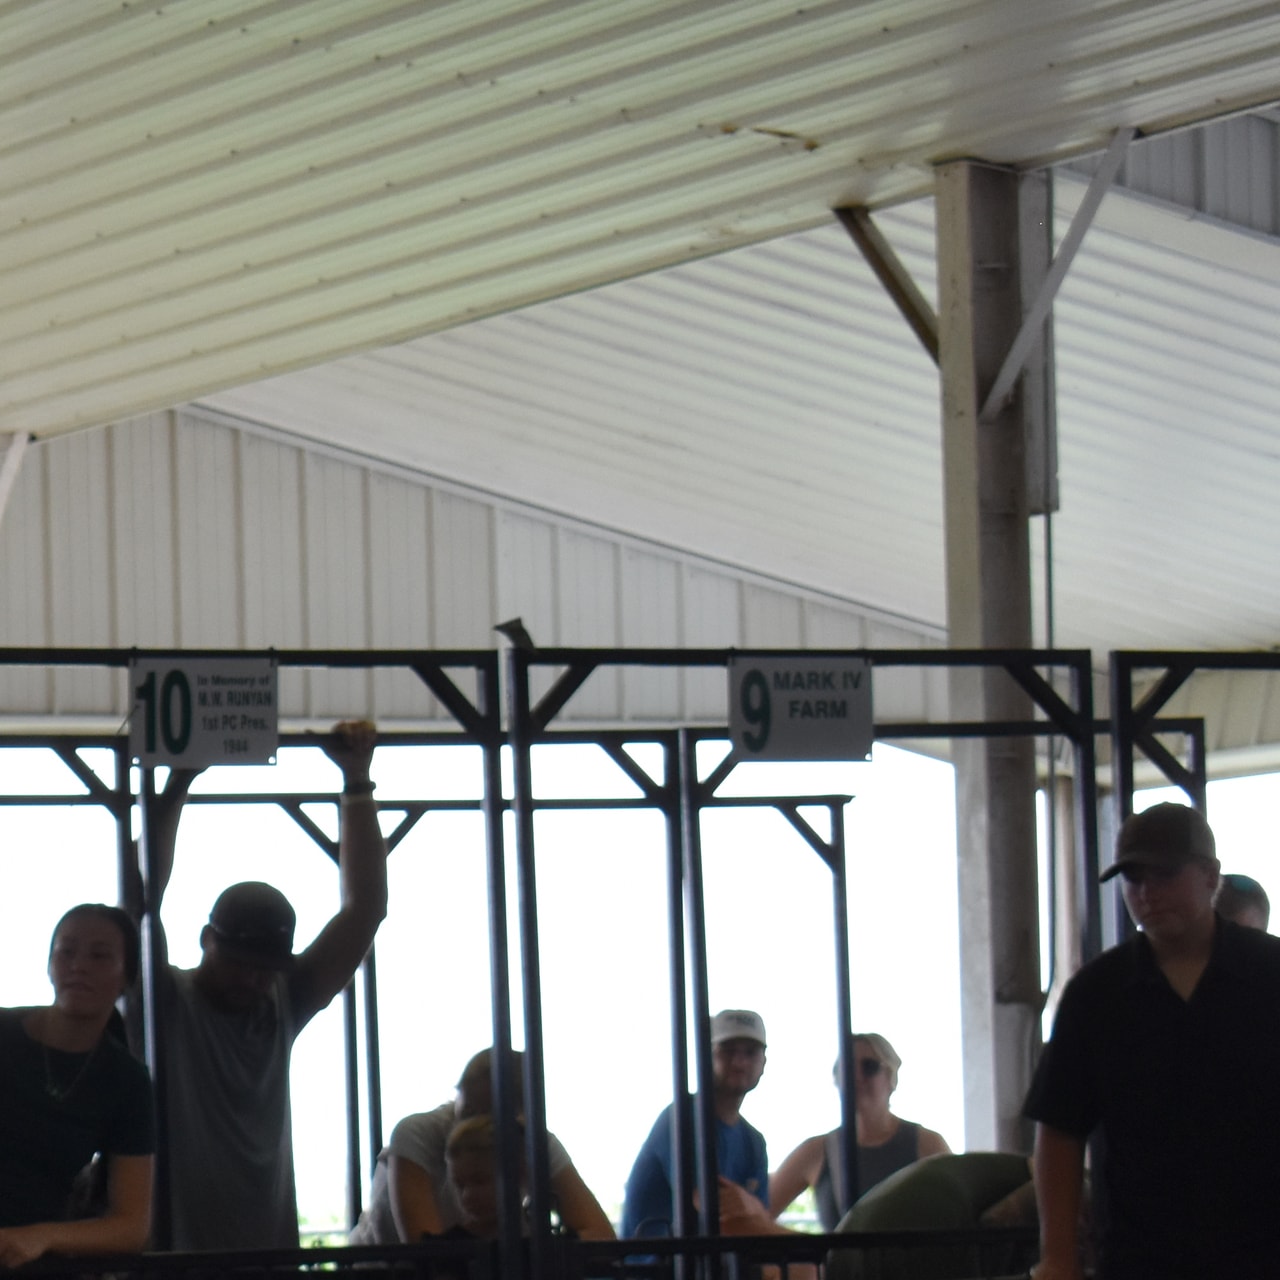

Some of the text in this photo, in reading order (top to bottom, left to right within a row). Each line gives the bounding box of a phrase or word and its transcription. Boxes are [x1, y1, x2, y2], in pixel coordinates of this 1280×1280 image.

[197, 675, 269, 688] In Memory of
[773, 671, 862, 690] MARK IV
[136, 669, 192, 754] 10
[741, 669, 771, 752] 9
[790, 700, 848, 718] FARM
[202, 717, 218, 730] 1st
[222, 716, 237, 731] PC
